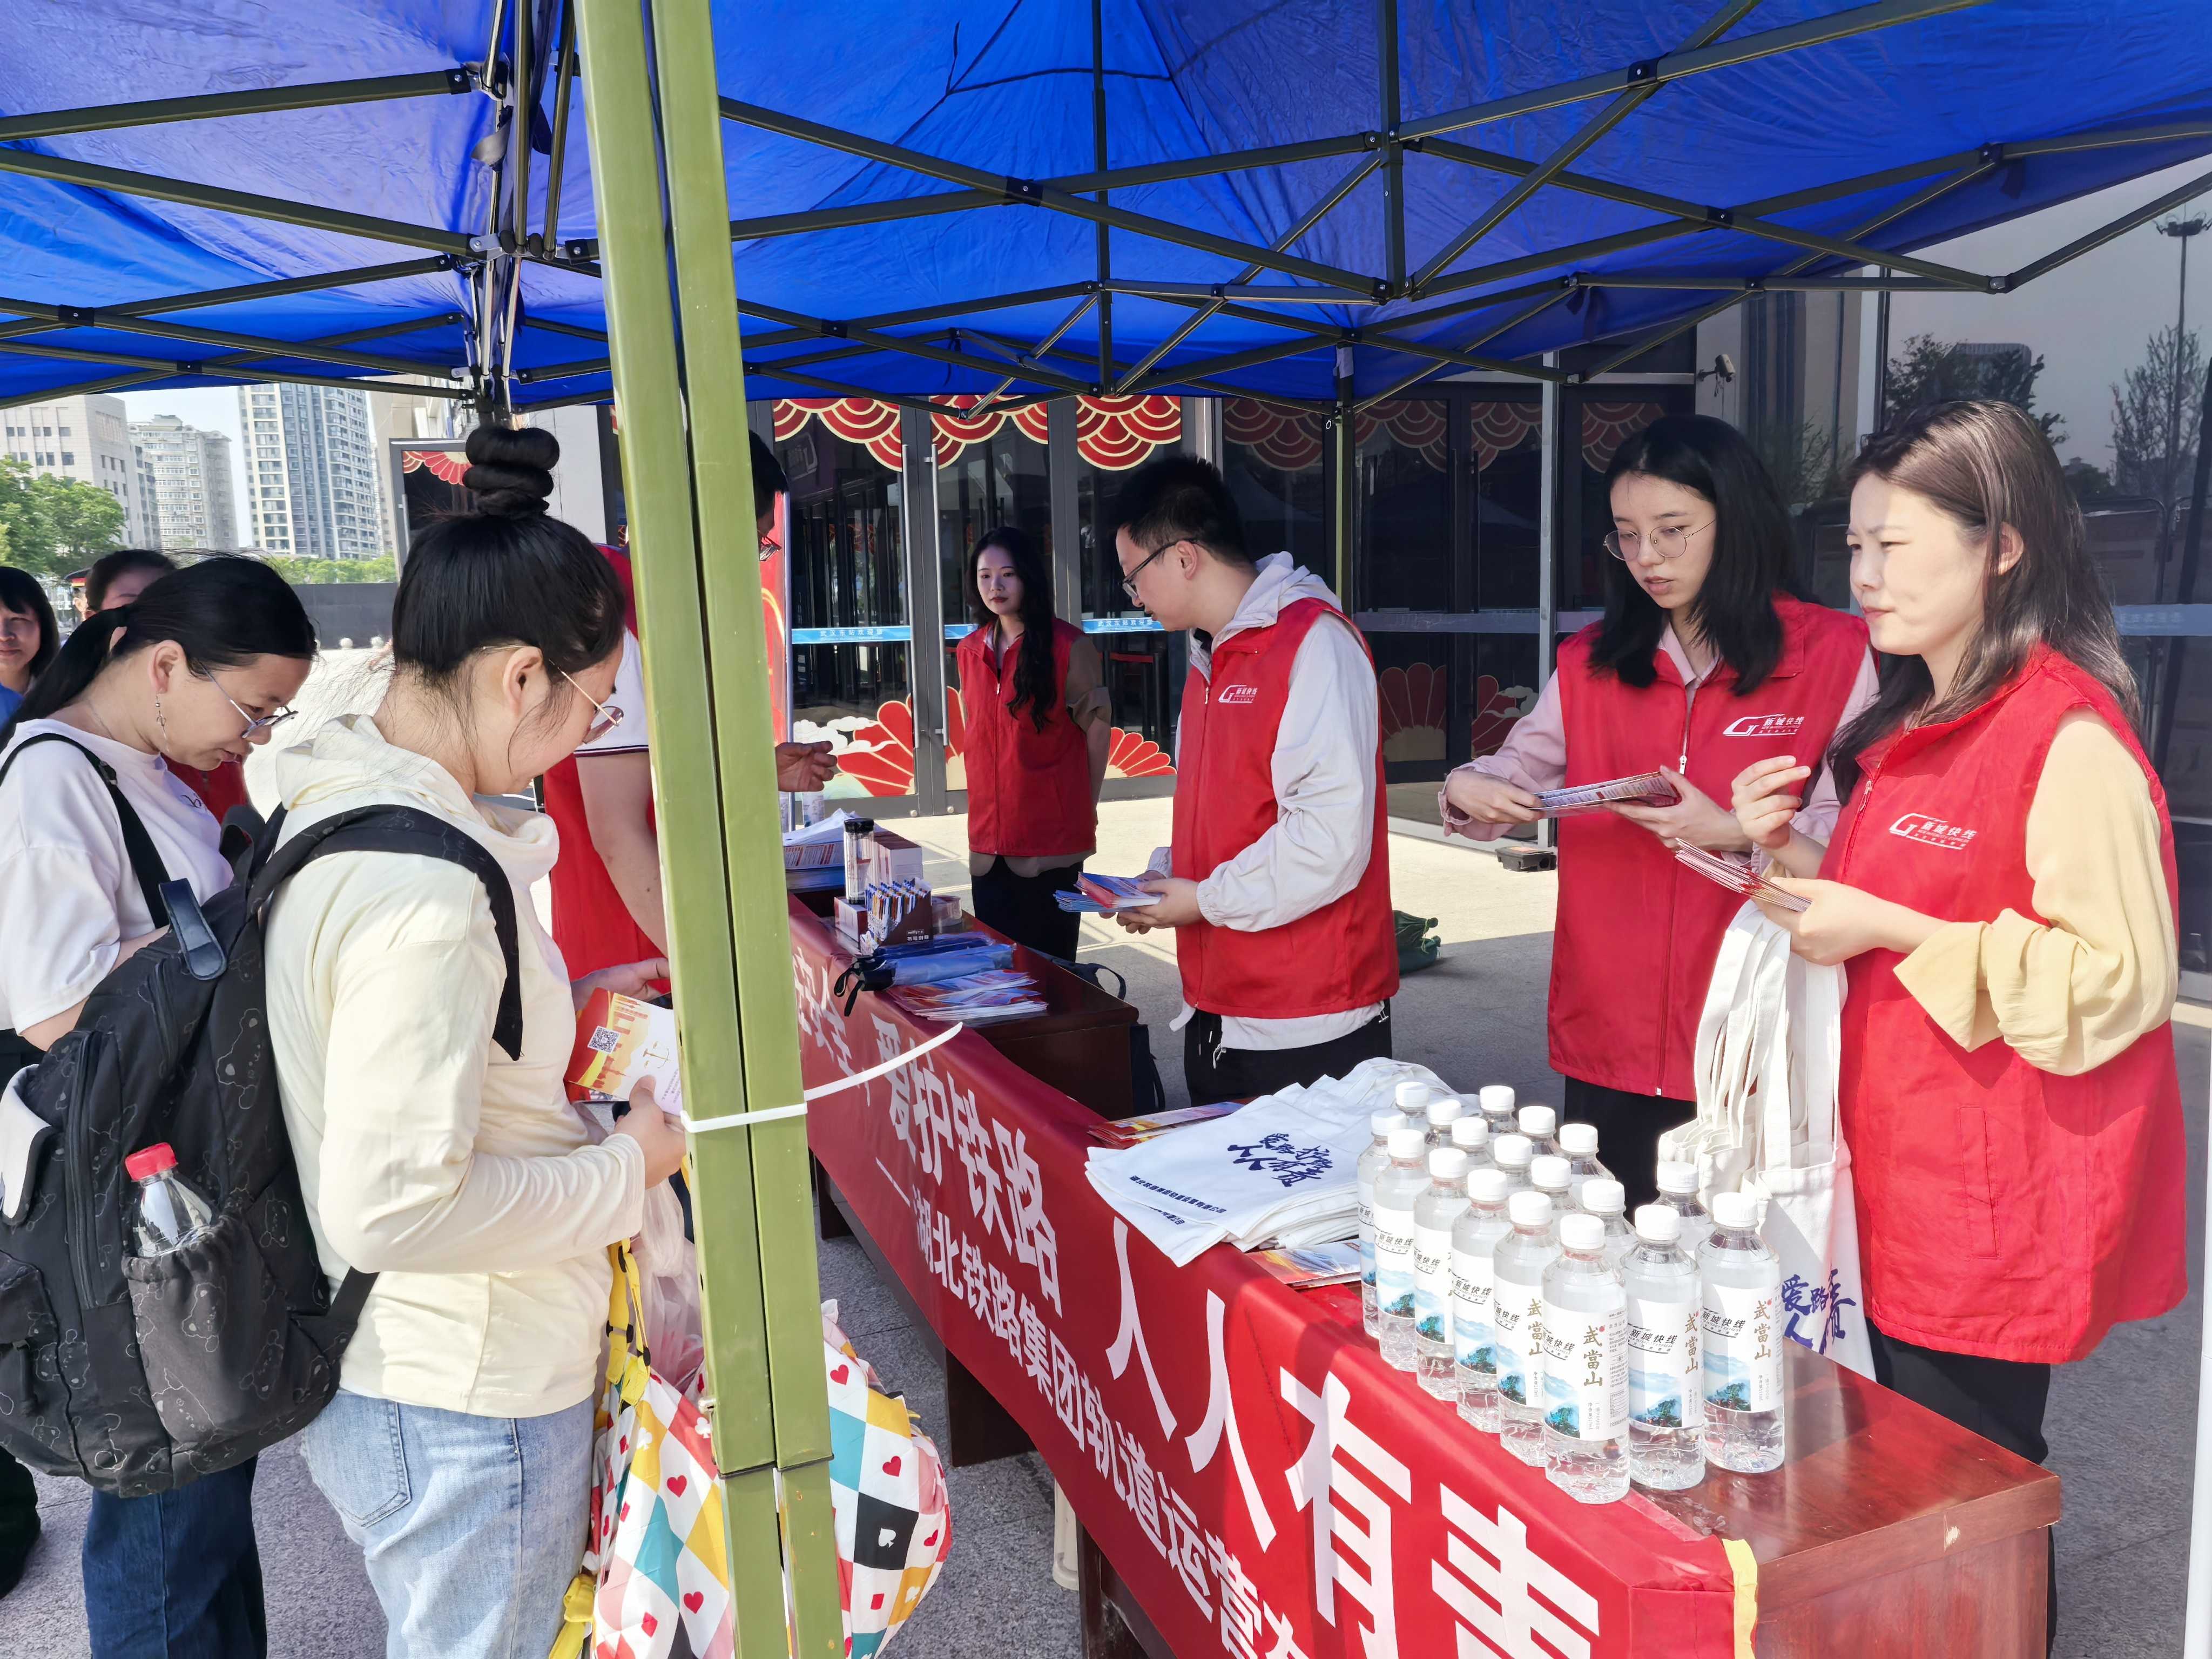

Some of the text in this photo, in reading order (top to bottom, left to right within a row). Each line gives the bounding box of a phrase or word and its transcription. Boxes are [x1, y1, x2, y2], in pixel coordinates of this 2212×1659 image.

[819, 628, 884, 637] 武汉东站欢迎您
[1763, 716, 1804, 726] 新城快线
[1920, 820, 1978, 840] 新城快线
[1455, 1279, 1492, 1296] 新城快线
[1495, 1304, 1520, 1323] 城快线
[1702, 1310, 1745, 1330] 新城快线
[1630, 1328, 1677, 1344] 新城快线
[1754, 1300, 1771, 1360] 武當山
[1545, 1334, 1575, 1352] 城快线
[1684, 1313, 1698, 1374] 武當山
[1583, 1325, 1603, 1387] 武當山
